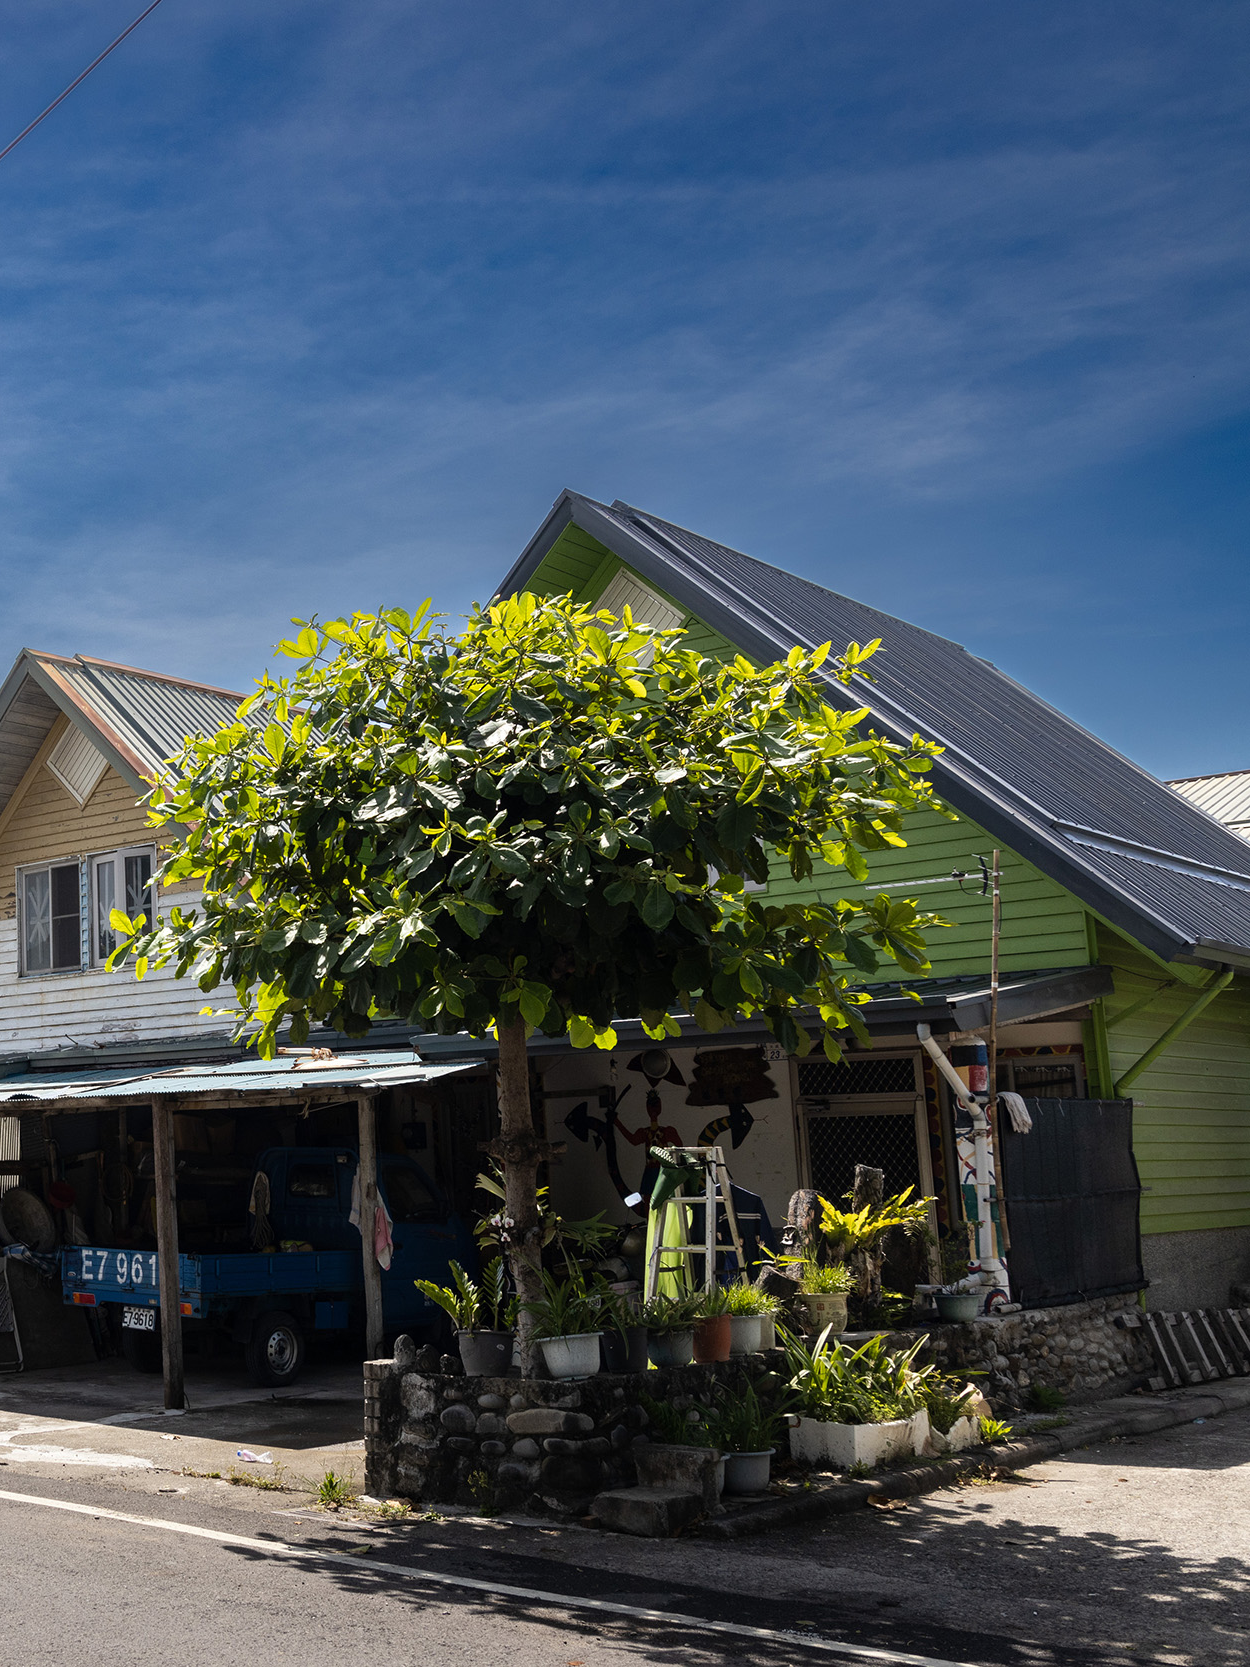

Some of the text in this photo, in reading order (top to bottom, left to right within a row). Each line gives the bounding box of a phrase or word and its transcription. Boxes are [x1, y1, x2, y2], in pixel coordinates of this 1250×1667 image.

[770, 1050, 780, 1059] 23
[81, 1249, 157, 1286] E7 961
[122, 1310, 154, 1328] E7-9618
